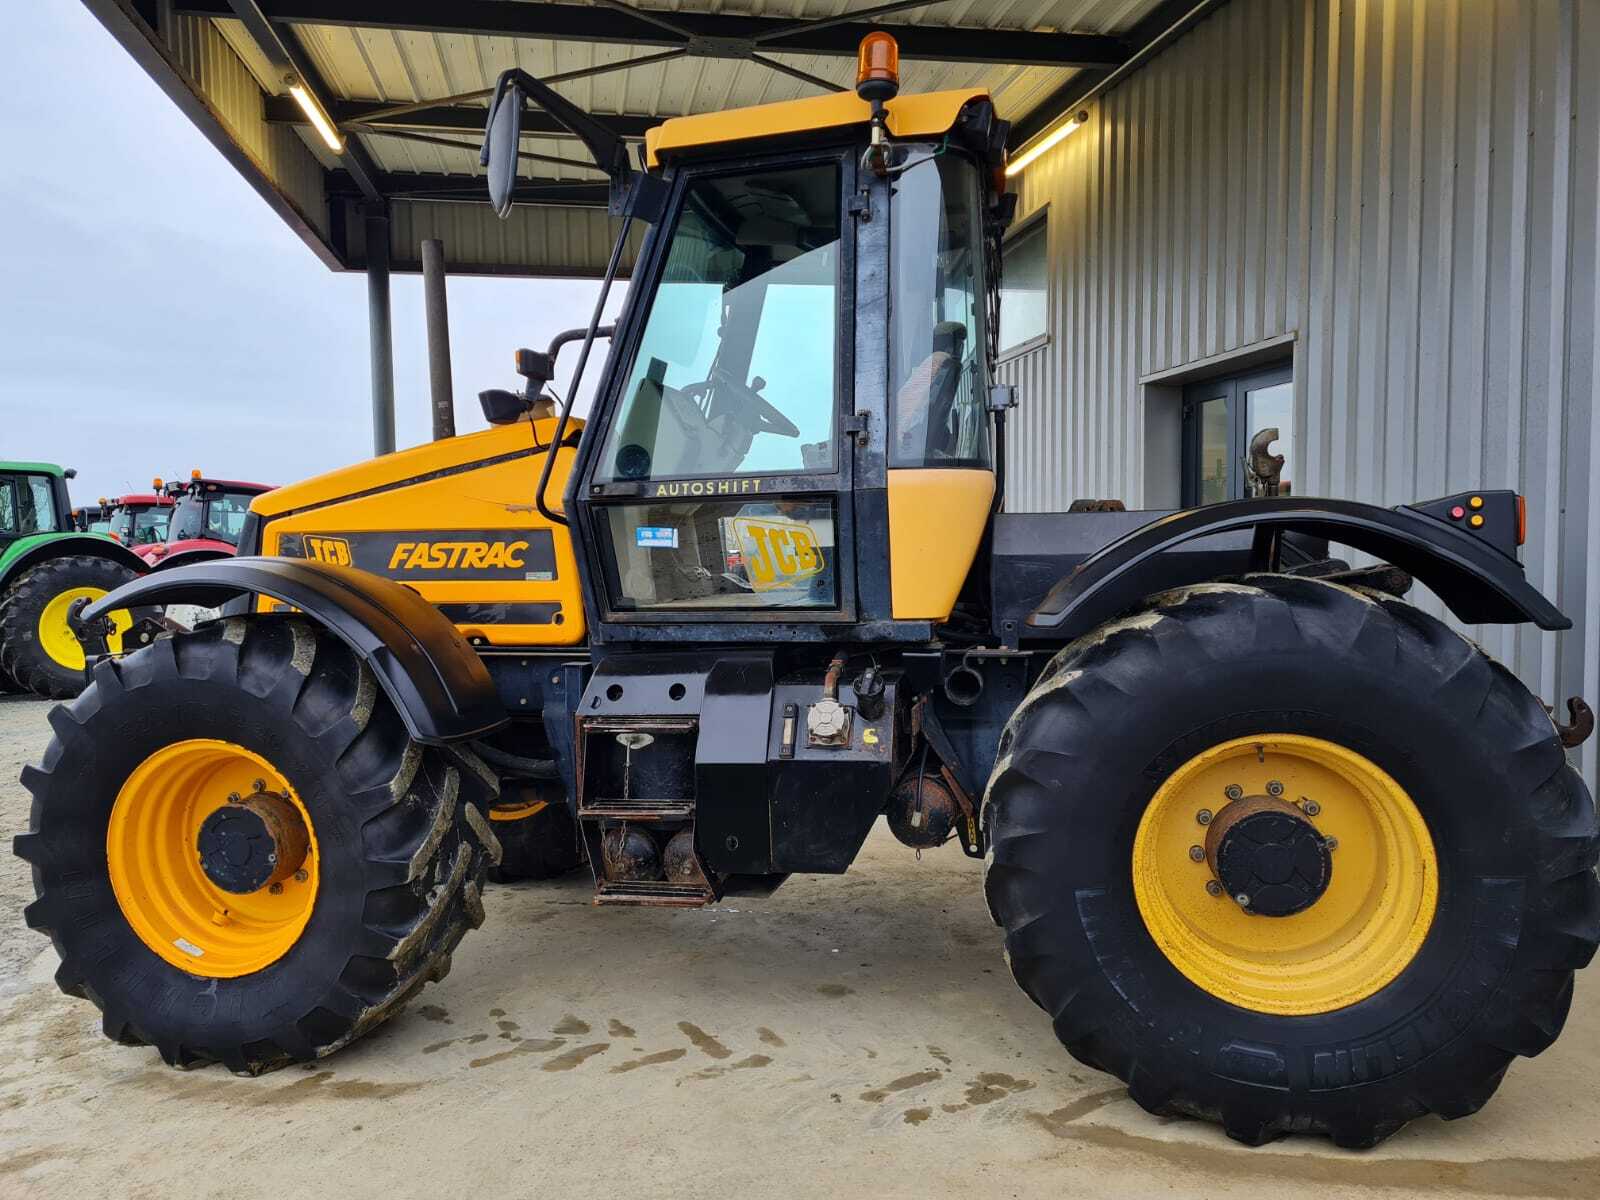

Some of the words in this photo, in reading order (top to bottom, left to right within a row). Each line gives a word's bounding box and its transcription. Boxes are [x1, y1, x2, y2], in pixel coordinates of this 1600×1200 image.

[656, 478, 762, 497] AUTOSHIFT
[308, 538, 350, 566] JCB
[388, 540, 530, 569] FASTRAC
[747, 525, 817, 582] JCB
